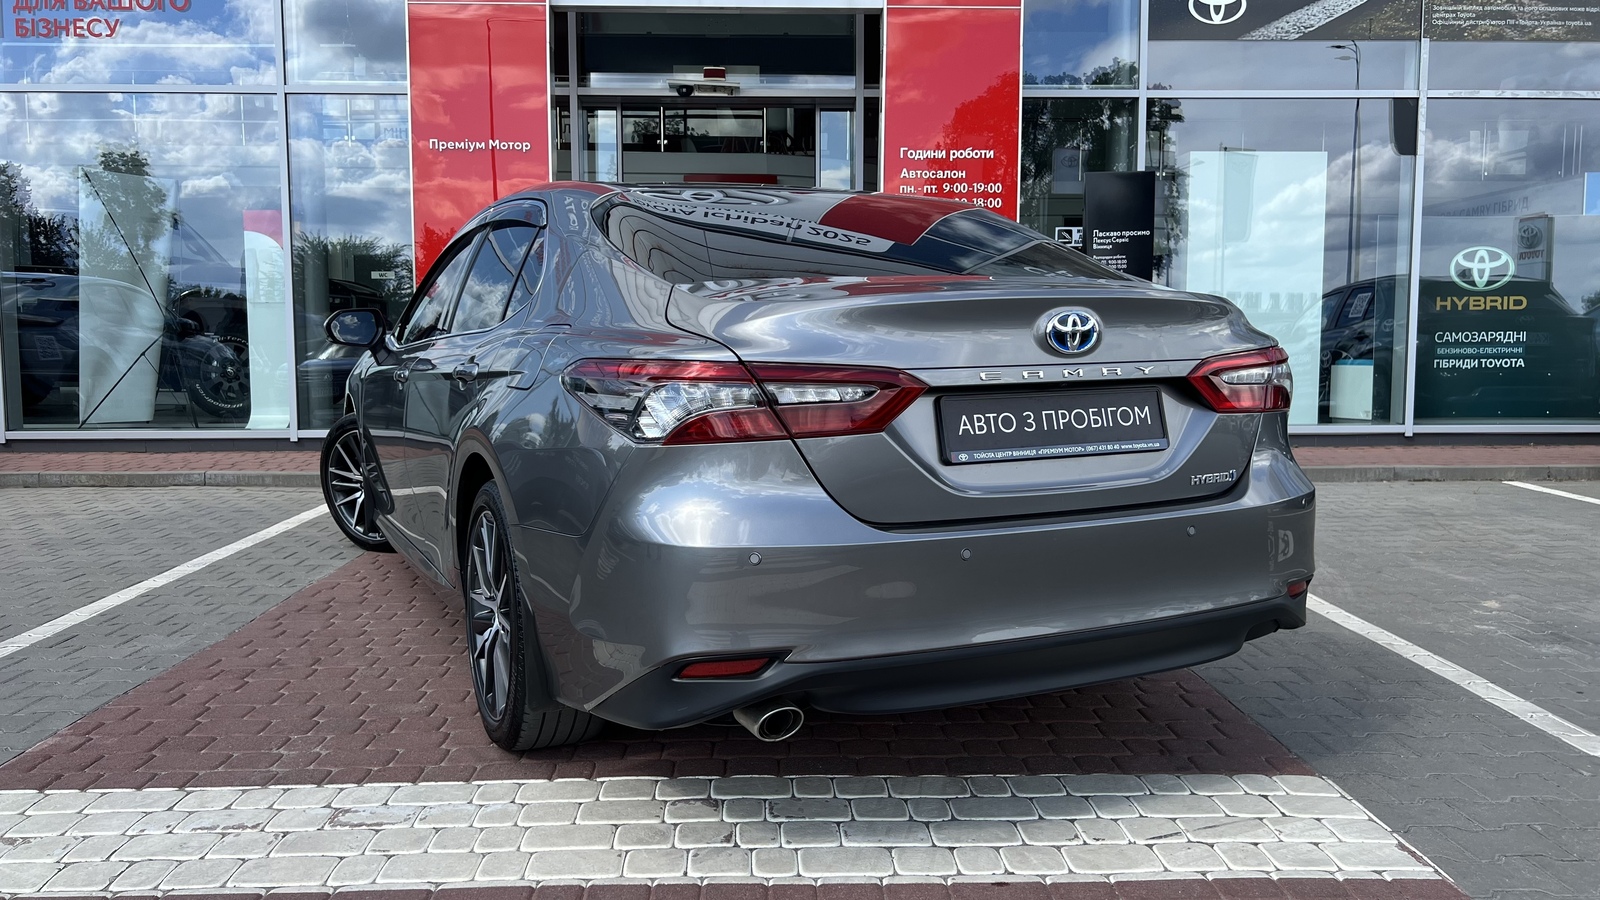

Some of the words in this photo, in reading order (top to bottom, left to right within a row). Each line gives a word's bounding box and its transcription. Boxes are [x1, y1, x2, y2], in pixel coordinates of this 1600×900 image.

[15, 18, 120, 38] БІЗНЕСУ
[429, 138, 486, 152] Преміум
[489, 139, 531, 152] Мотор
[900, 147, 946, 160] Години
[949, 147, 994, 161] роботи
[900, 168, 966, 179] Автосалон
[943, 182, 1002, 193] 9:00-19:00
[1093, 229, 1121, 237] Ласкаво
[1122, 230, 1150, 238] просимо
[1435, 295, 1528, 311] HYBRID
[1434, 331, 1527, 343] САМОЗАРЯДНІ
[1437, 347, 1523, 355] БЕНЗИНОВО-ЕЛЕКТРИЧНІ
[1434, 359, 1478, 369] ГІБРИДИ
[1480, 358, 1525, 369] TOYOTA
[979, 365, 1156, 381] CAMRY
[958, 412, 1017, 436] АВТО
[1023, 411, 1037, 432] З
[1041, 405, 1152, 431] ПРОБІГОМ
[995, 451, 1012, 459] ЦЕНТР
[1013, 449, 1037, 458] ВІННИЦЯ
[1191, 472, 1232, 486] HYBRID
